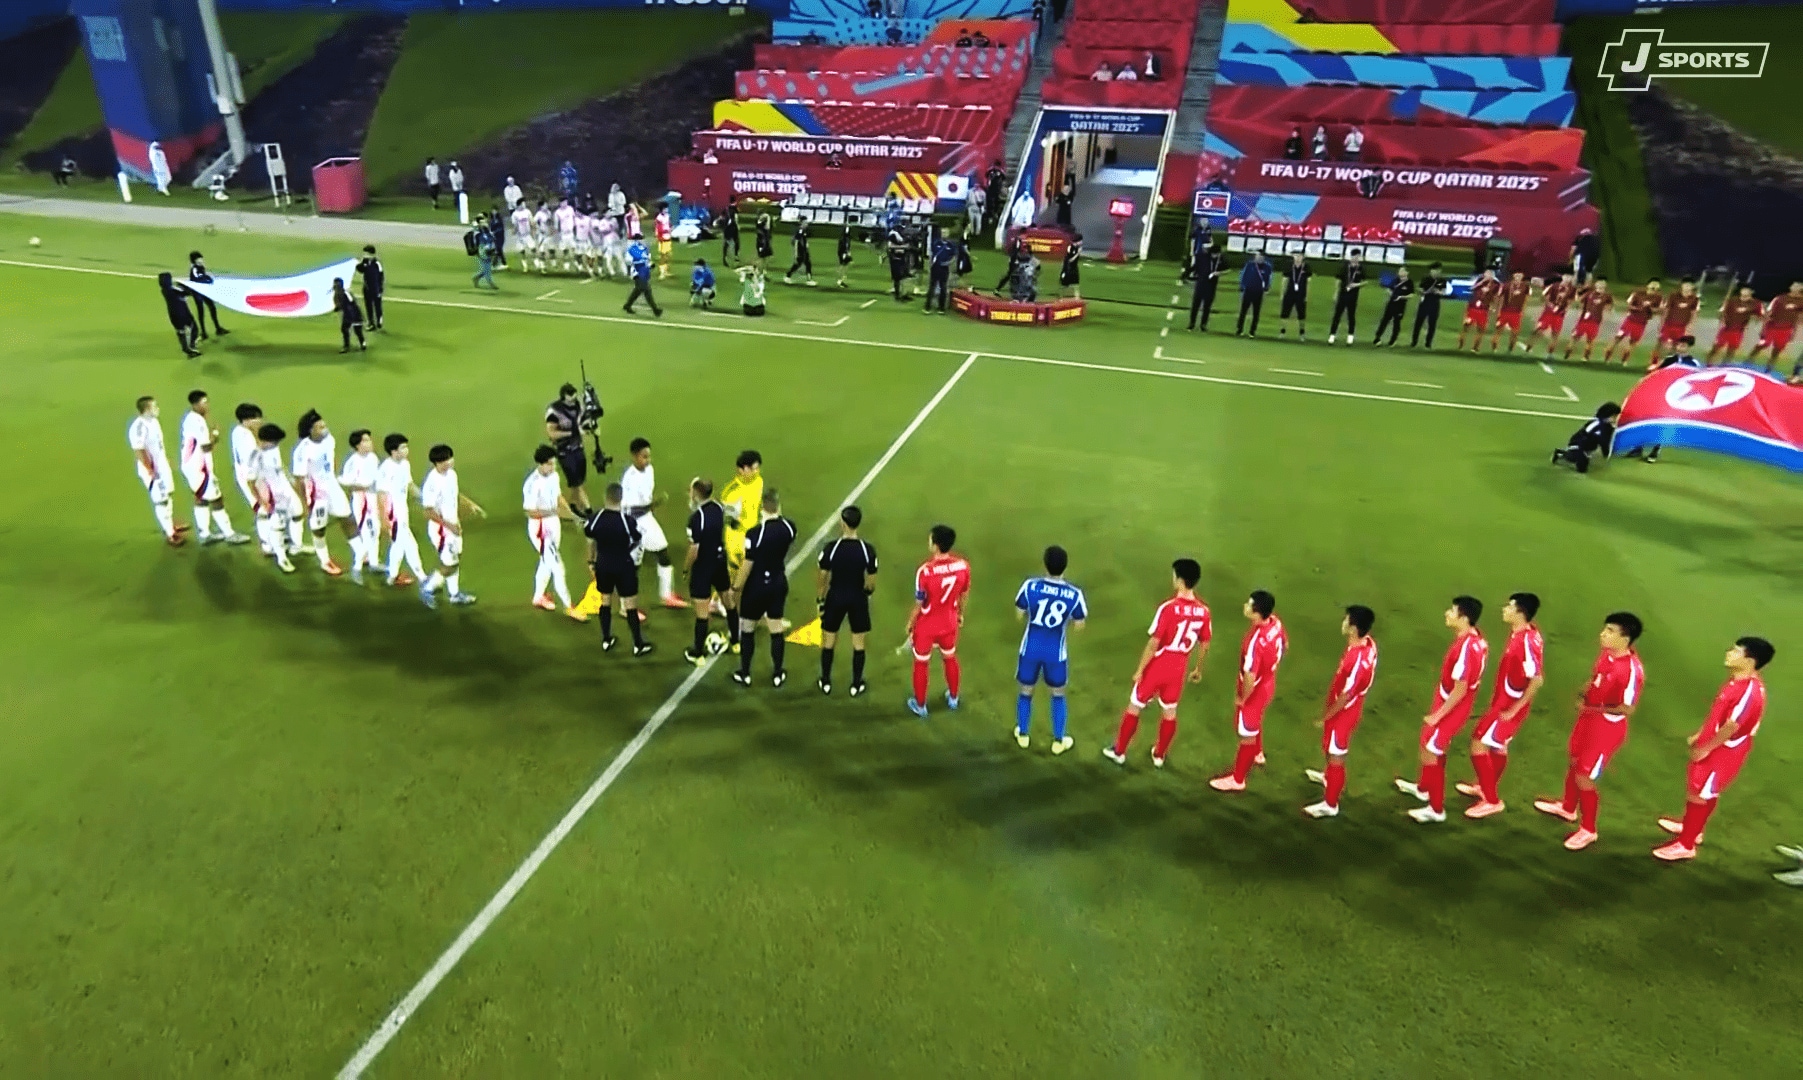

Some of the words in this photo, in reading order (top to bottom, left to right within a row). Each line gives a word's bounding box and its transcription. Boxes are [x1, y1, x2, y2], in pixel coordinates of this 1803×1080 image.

[1070, 121, 1110, 131] QATAR
[716, 138, 742, 150] FIFA
[743, 139, 769, 151] U-17
[771, 140, 816, 153] WORLD
[817, 143, 843, 154] CUP
[845, 143, 889, 158] QATAR
[733, 180, 775, 193] QATAR
[1260, 163, 1294, 178] FIFA
[1296, 165, 1332, 180] U-17
[1397, 171, 1432, 185] CUP
[1433, 172, 1494, 188] QATAR
[1392, 209, 1415, 220] FIFA
[1415, 211, 1438, 221] U-17
[1438, 212, 1475, 223] WORLD
[1476, 214, 1499, 224] CUP
[940, 575, 957, 604] 7
[1031, 598, 1067, 628] 18
[1165, 619, 1204, 653] 15
